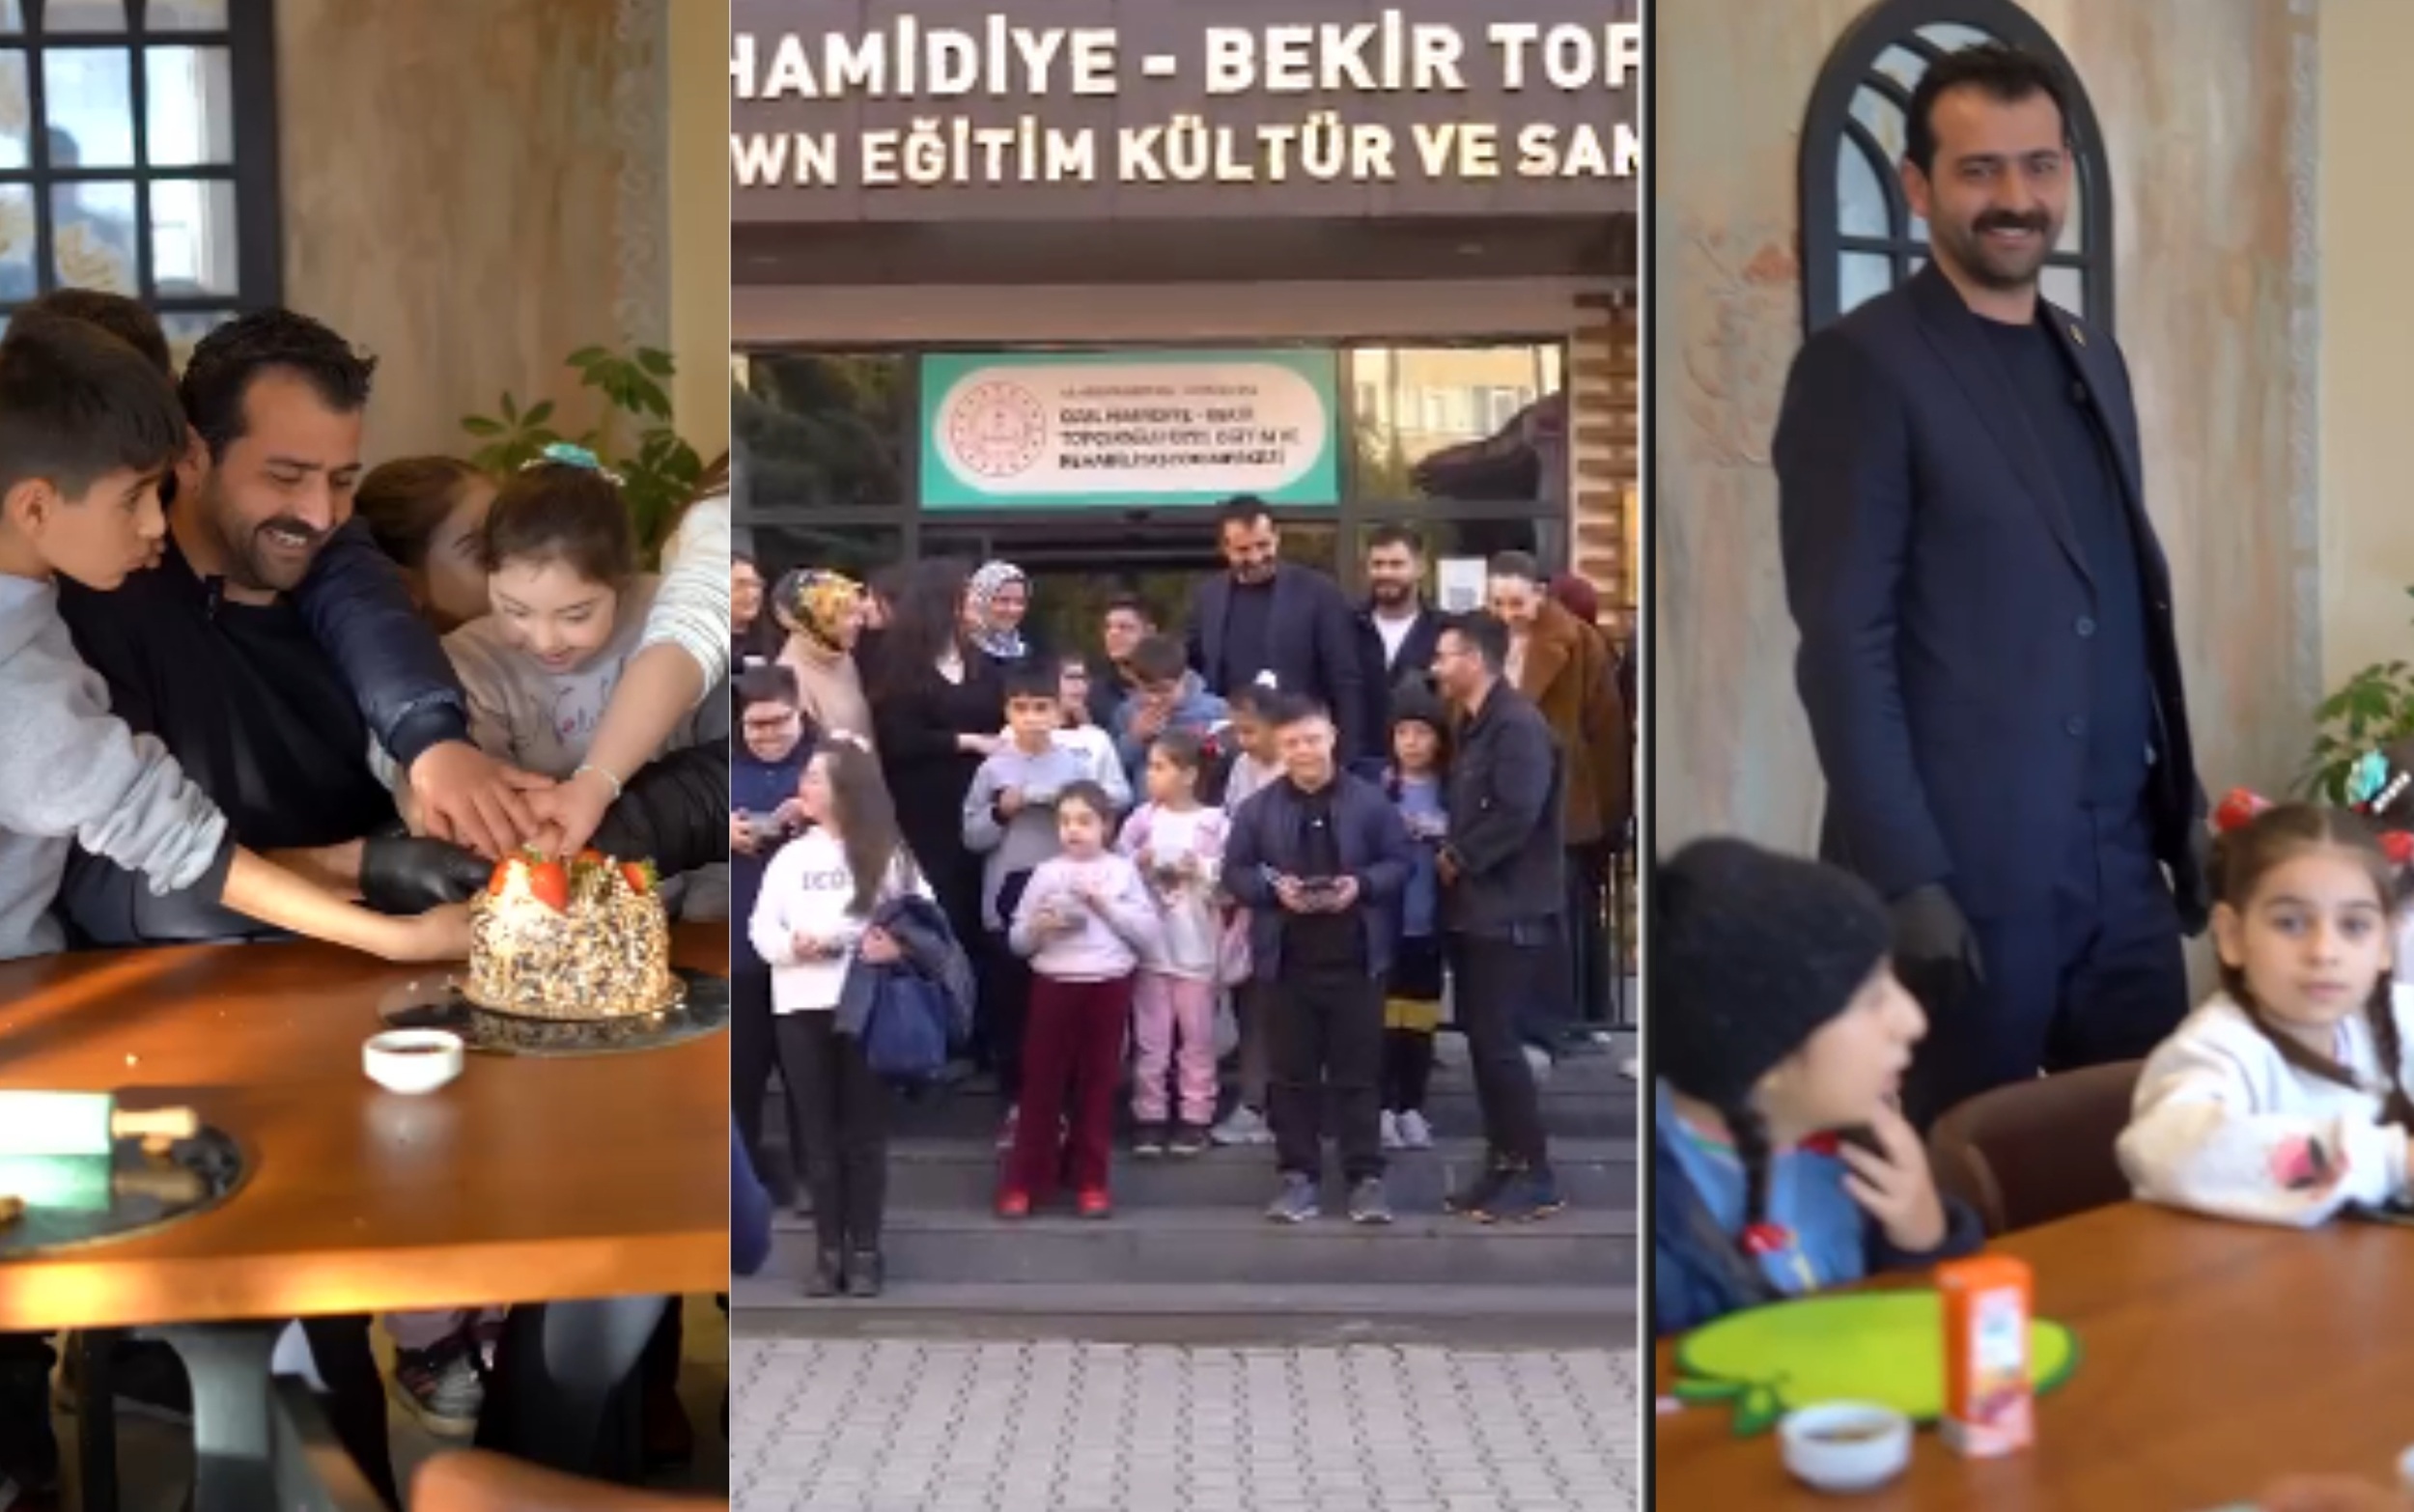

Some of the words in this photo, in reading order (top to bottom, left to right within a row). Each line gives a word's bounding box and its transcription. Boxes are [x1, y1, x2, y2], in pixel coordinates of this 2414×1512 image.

[1205, 9, 1466, 93] BEKİR
[861, 114, 1095, 184] EĞİTİM
[1118, 110, 1395, 182] KÜLTÜR
[1412, 123, 1501, 178] VE
